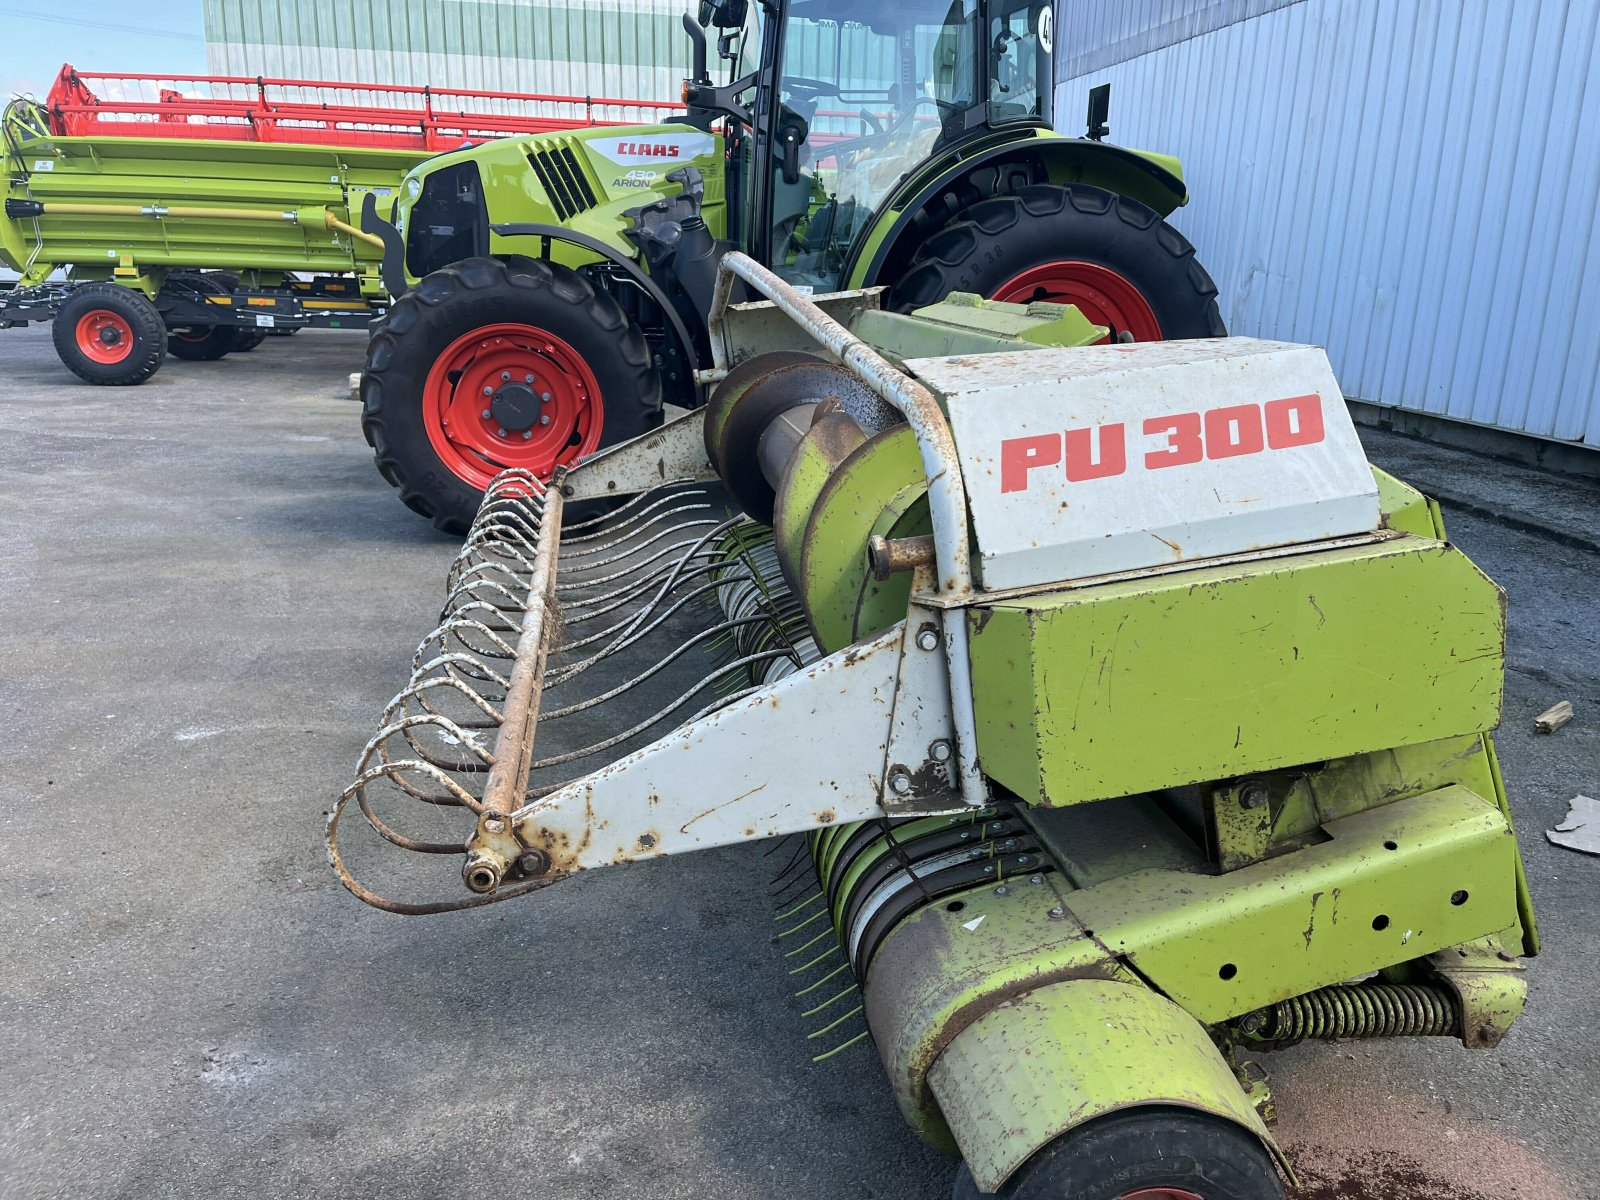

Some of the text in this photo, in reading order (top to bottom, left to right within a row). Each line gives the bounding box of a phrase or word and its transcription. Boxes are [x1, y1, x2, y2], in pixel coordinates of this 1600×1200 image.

[618, 143, 679, 157] CLAAS
[624, 170, 657, 180] 430
[612, 178, 649, 188] ARION
[984, 244, 1005, 265] 38
[1000, 393, 1326, 494] PU 300
